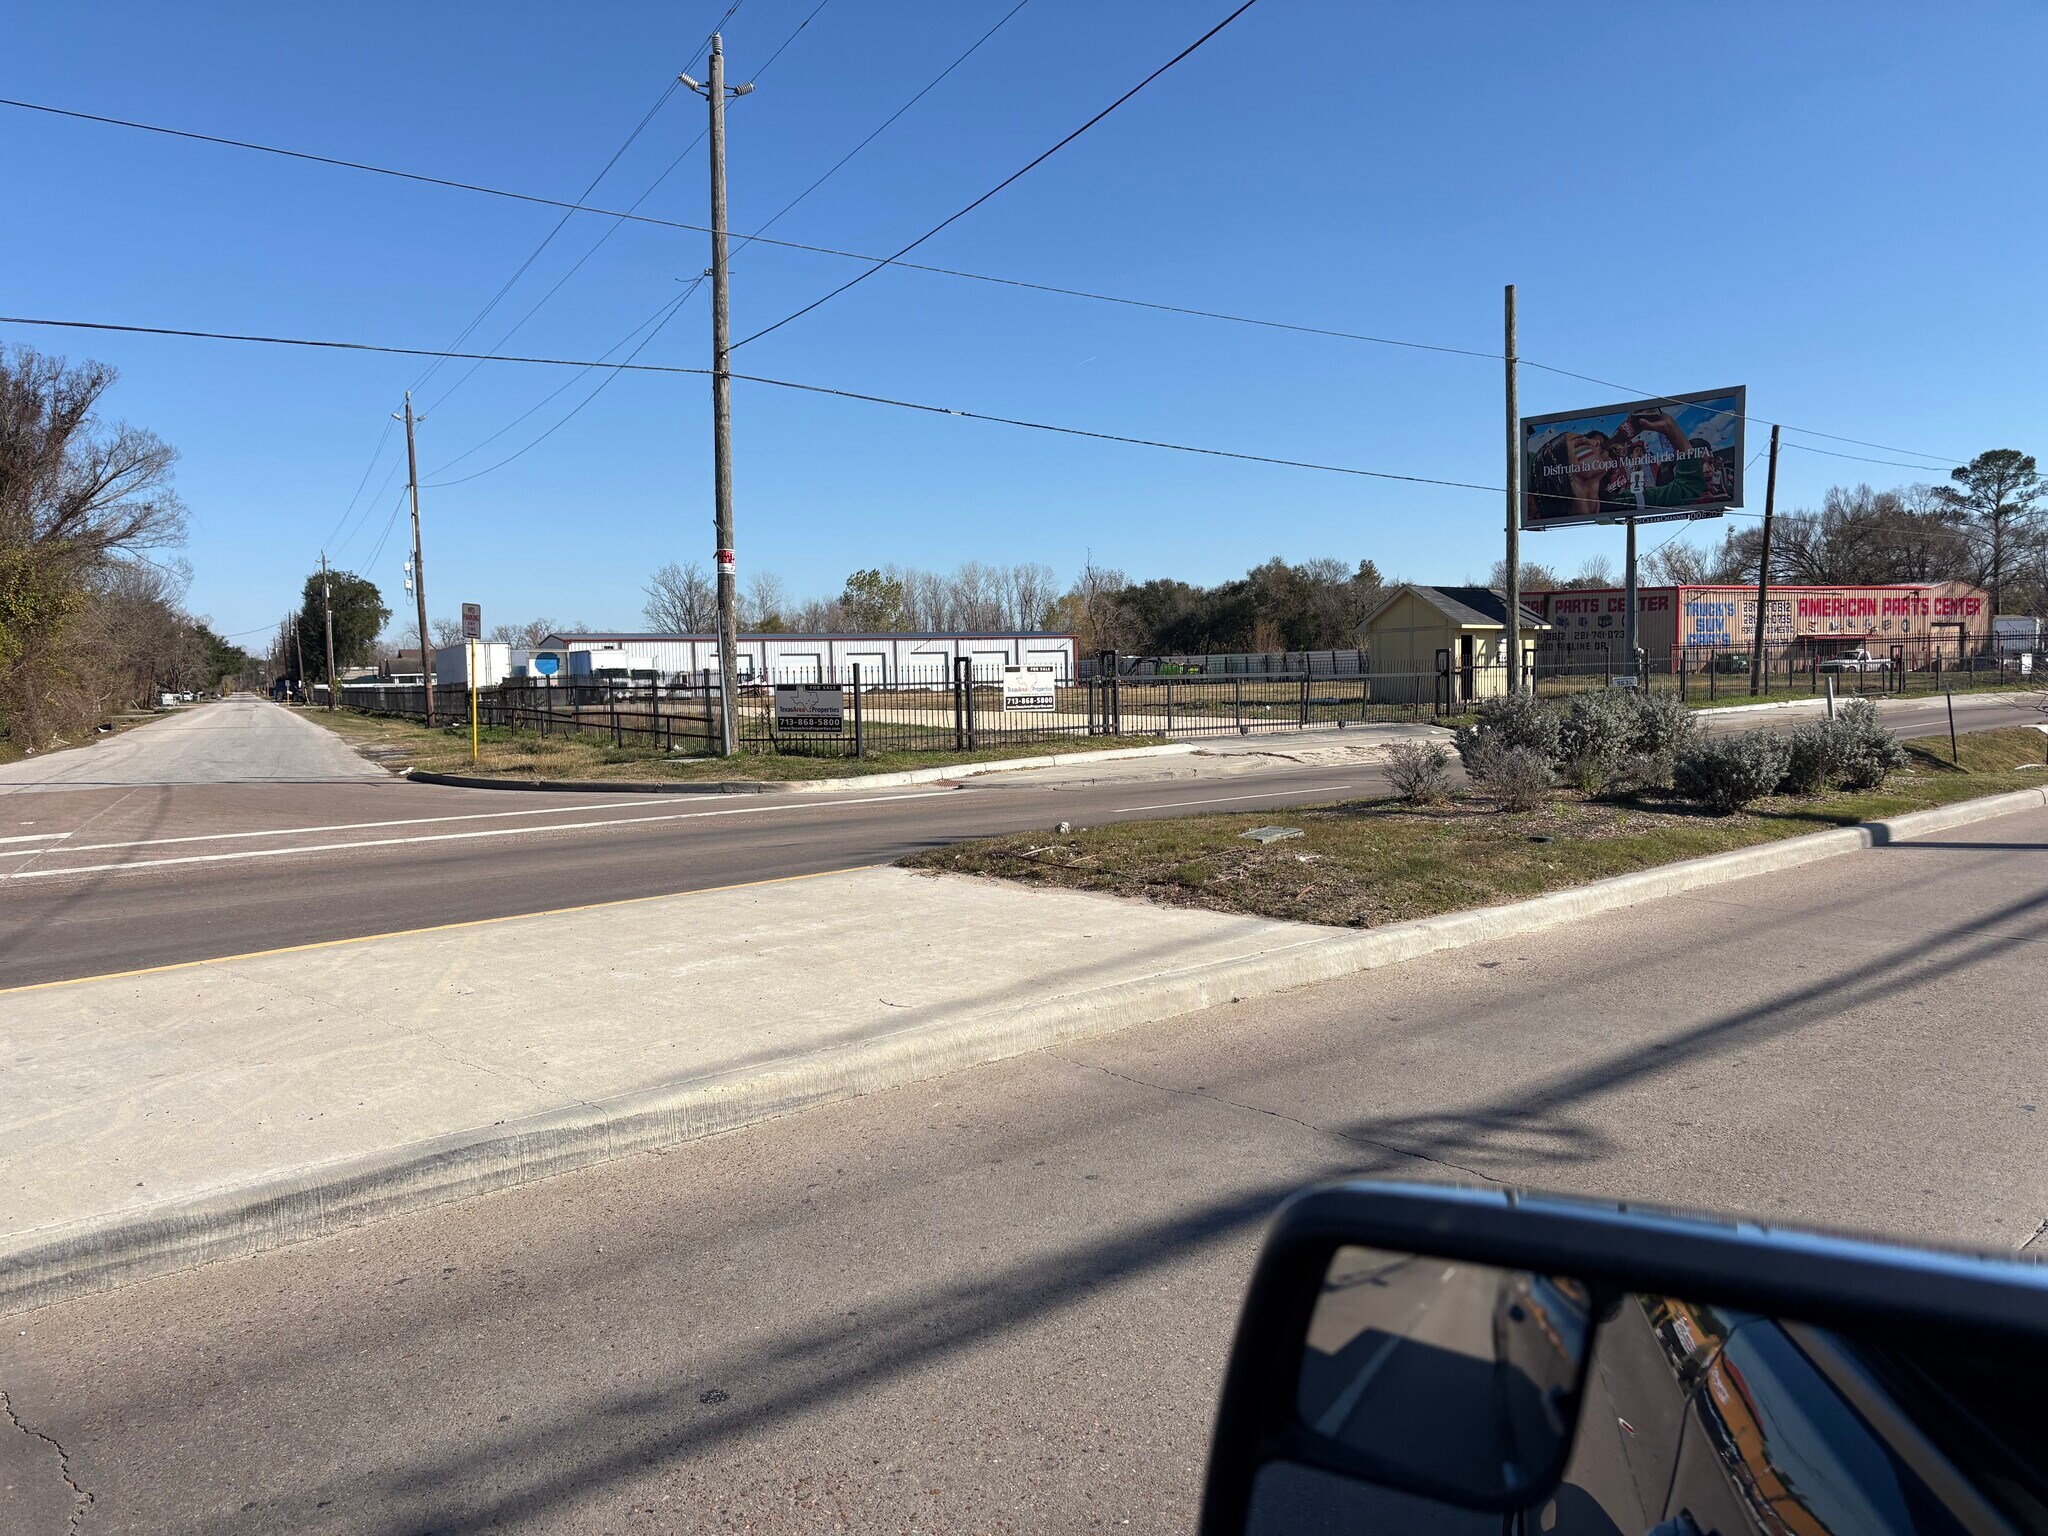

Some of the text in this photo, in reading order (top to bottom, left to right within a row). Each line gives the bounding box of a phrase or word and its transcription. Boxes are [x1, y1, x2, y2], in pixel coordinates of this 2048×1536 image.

[1543, 446, 1712, 477] Disfruta la Copa Mundial de la FIFA
[1555, 598, 1600, 614] PARTS
[1608, 595, 1669, 613] CETER
[1685, 602, 1734, 616] TRUCK'S
[1798, 598, 1981, 616] AMERICAN PARTS CENTER
[1696, 618, 1724, 632] SUV
[1574, 630, 1624, 640] 281-741-073
